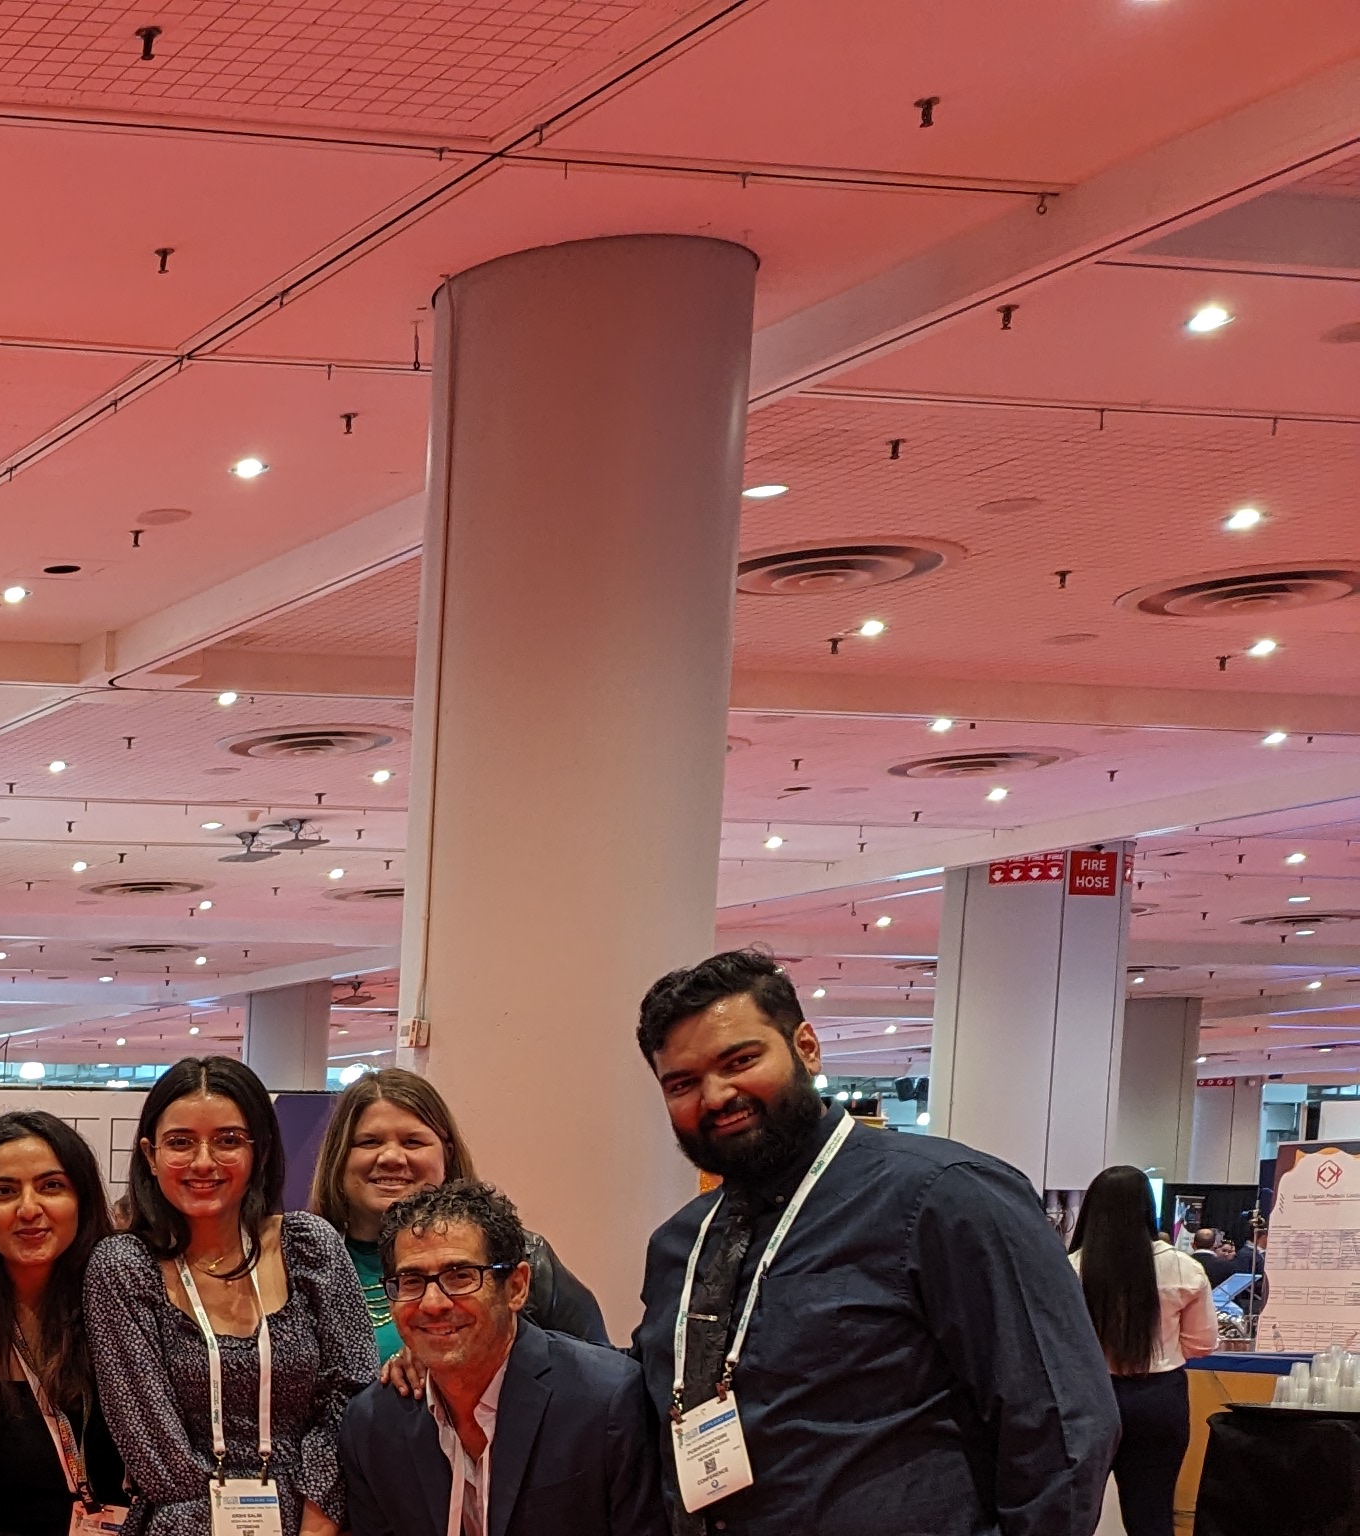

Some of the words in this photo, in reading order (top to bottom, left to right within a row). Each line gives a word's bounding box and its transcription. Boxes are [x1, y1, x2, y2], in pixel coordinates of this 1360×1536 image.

[1081, 859, 1107, 871] FIRE
[1076, 876, 1110, 889] HOSE
[697, 1466, 729, 1486] CONFERENCE
